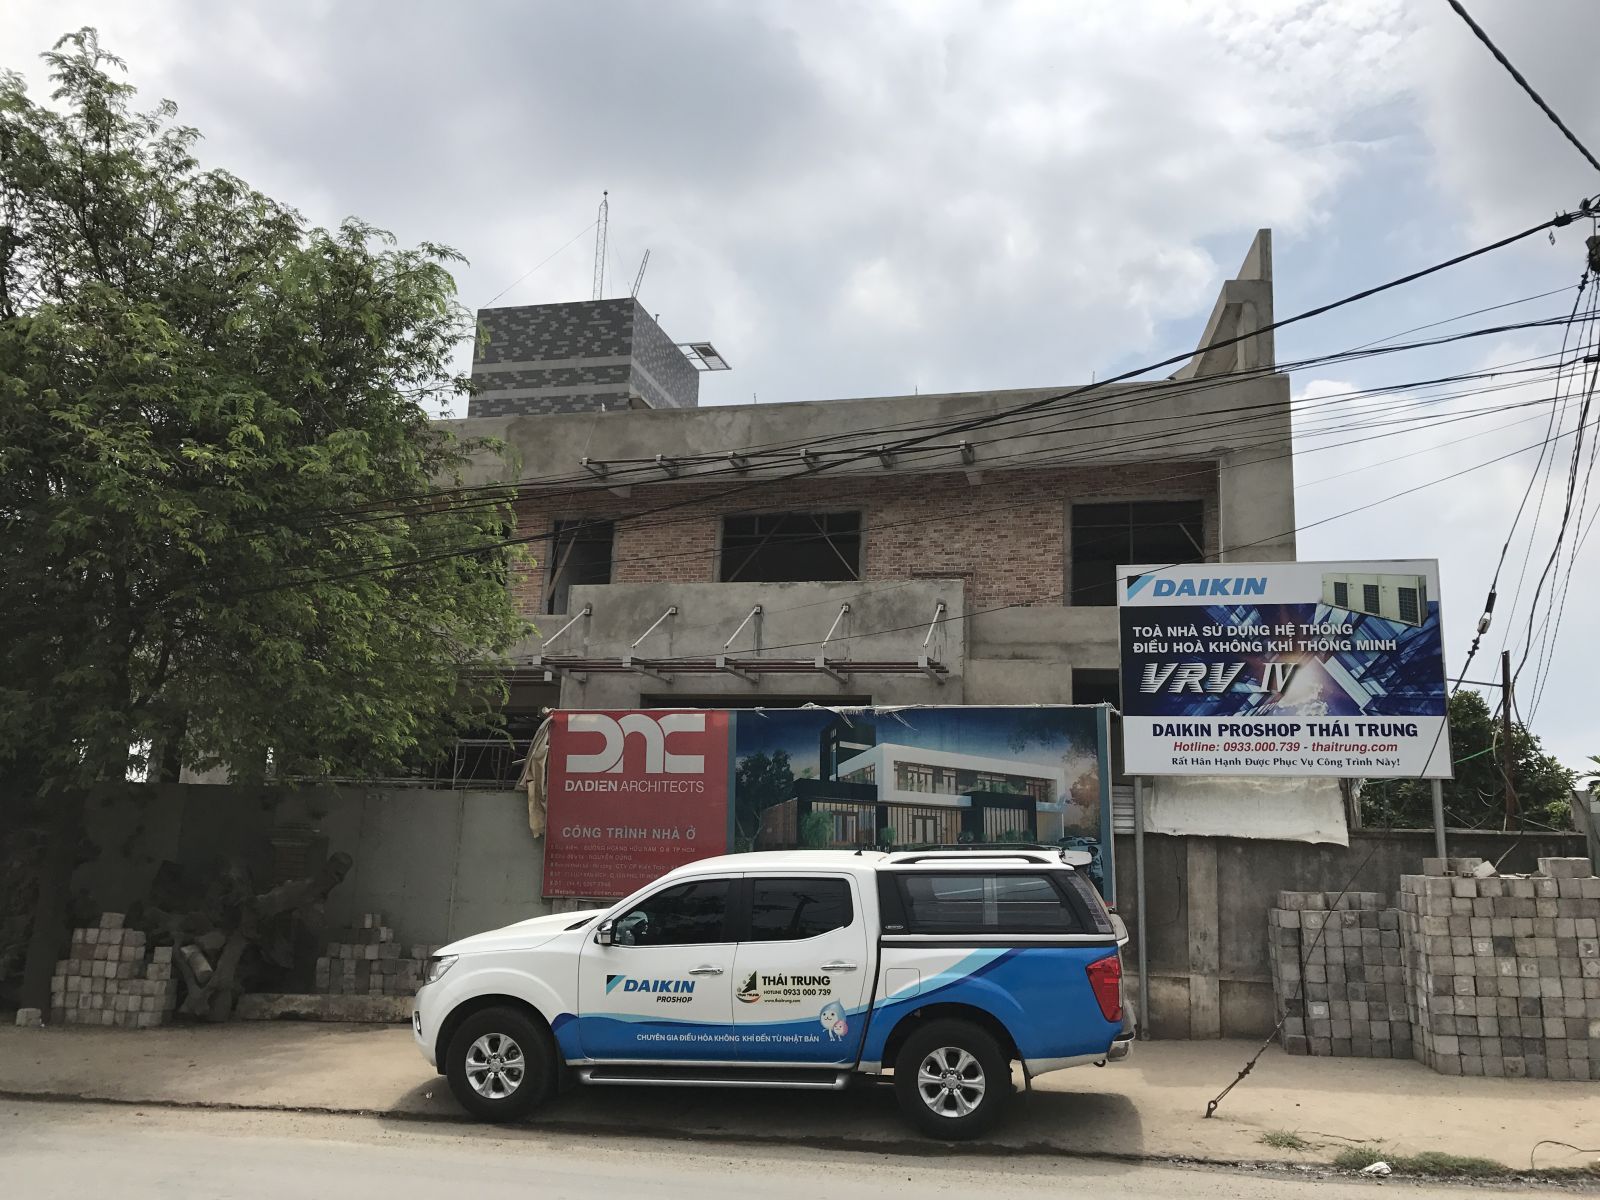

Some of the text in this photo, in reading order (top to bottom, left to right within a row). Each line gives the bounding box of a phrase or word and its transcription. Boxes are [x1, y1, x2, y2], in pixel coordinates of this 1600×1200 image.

[1153, 577, 1267, 597] DAIKIN
[1133, 624, 1163, 637] TOÀ
[1167, 624, 1198, 637] NHÀ
[1202, 623, 1224, 637] SỬ
[1227, 625, 1270, 639] DỤNG
[1275, 622, 1296, 637] HỆ
[1133, 638, 1397, 653] ĐIỀU HOÀ KHÔNG KHÍ THÔNG MINH
[1139, 662, 1299, 694] VRV IV
[1152, 720, 1418, 737] DAIKIN PROSHOP THÁI TRUNG
[1173, 742, 1220, 752] Hotline:
[1223, 742, 1300, 752] 0933.000.739
[1312, 742, 1398, 754] thaitrung.com
[1172, 756, 1188, 766] Rất
[1191, 757, 1211, 766] Hân
[1215, 757, 1241, 767] Hạnh
[1245, 758, 1270, 767] Được
[1273, 758, 1297, 767] Phục
[1300, 758, 1314, 767] Vụ
[1317, 757, 1343, 768] Công
[1346, 757, 1373, 766] Trình
[565, 780, 704, 793] DADIEN ARCHITECTS
[623, 979, 695, 993] DAIKIN
[762, 973, 831, 986] THÁI TRUNG
[636, 1033, 665, 1041] CHUYÊN
[714, 1033, 740, 1042] KHÔNG
[783, 1034, 803, 1044] NHẬT
